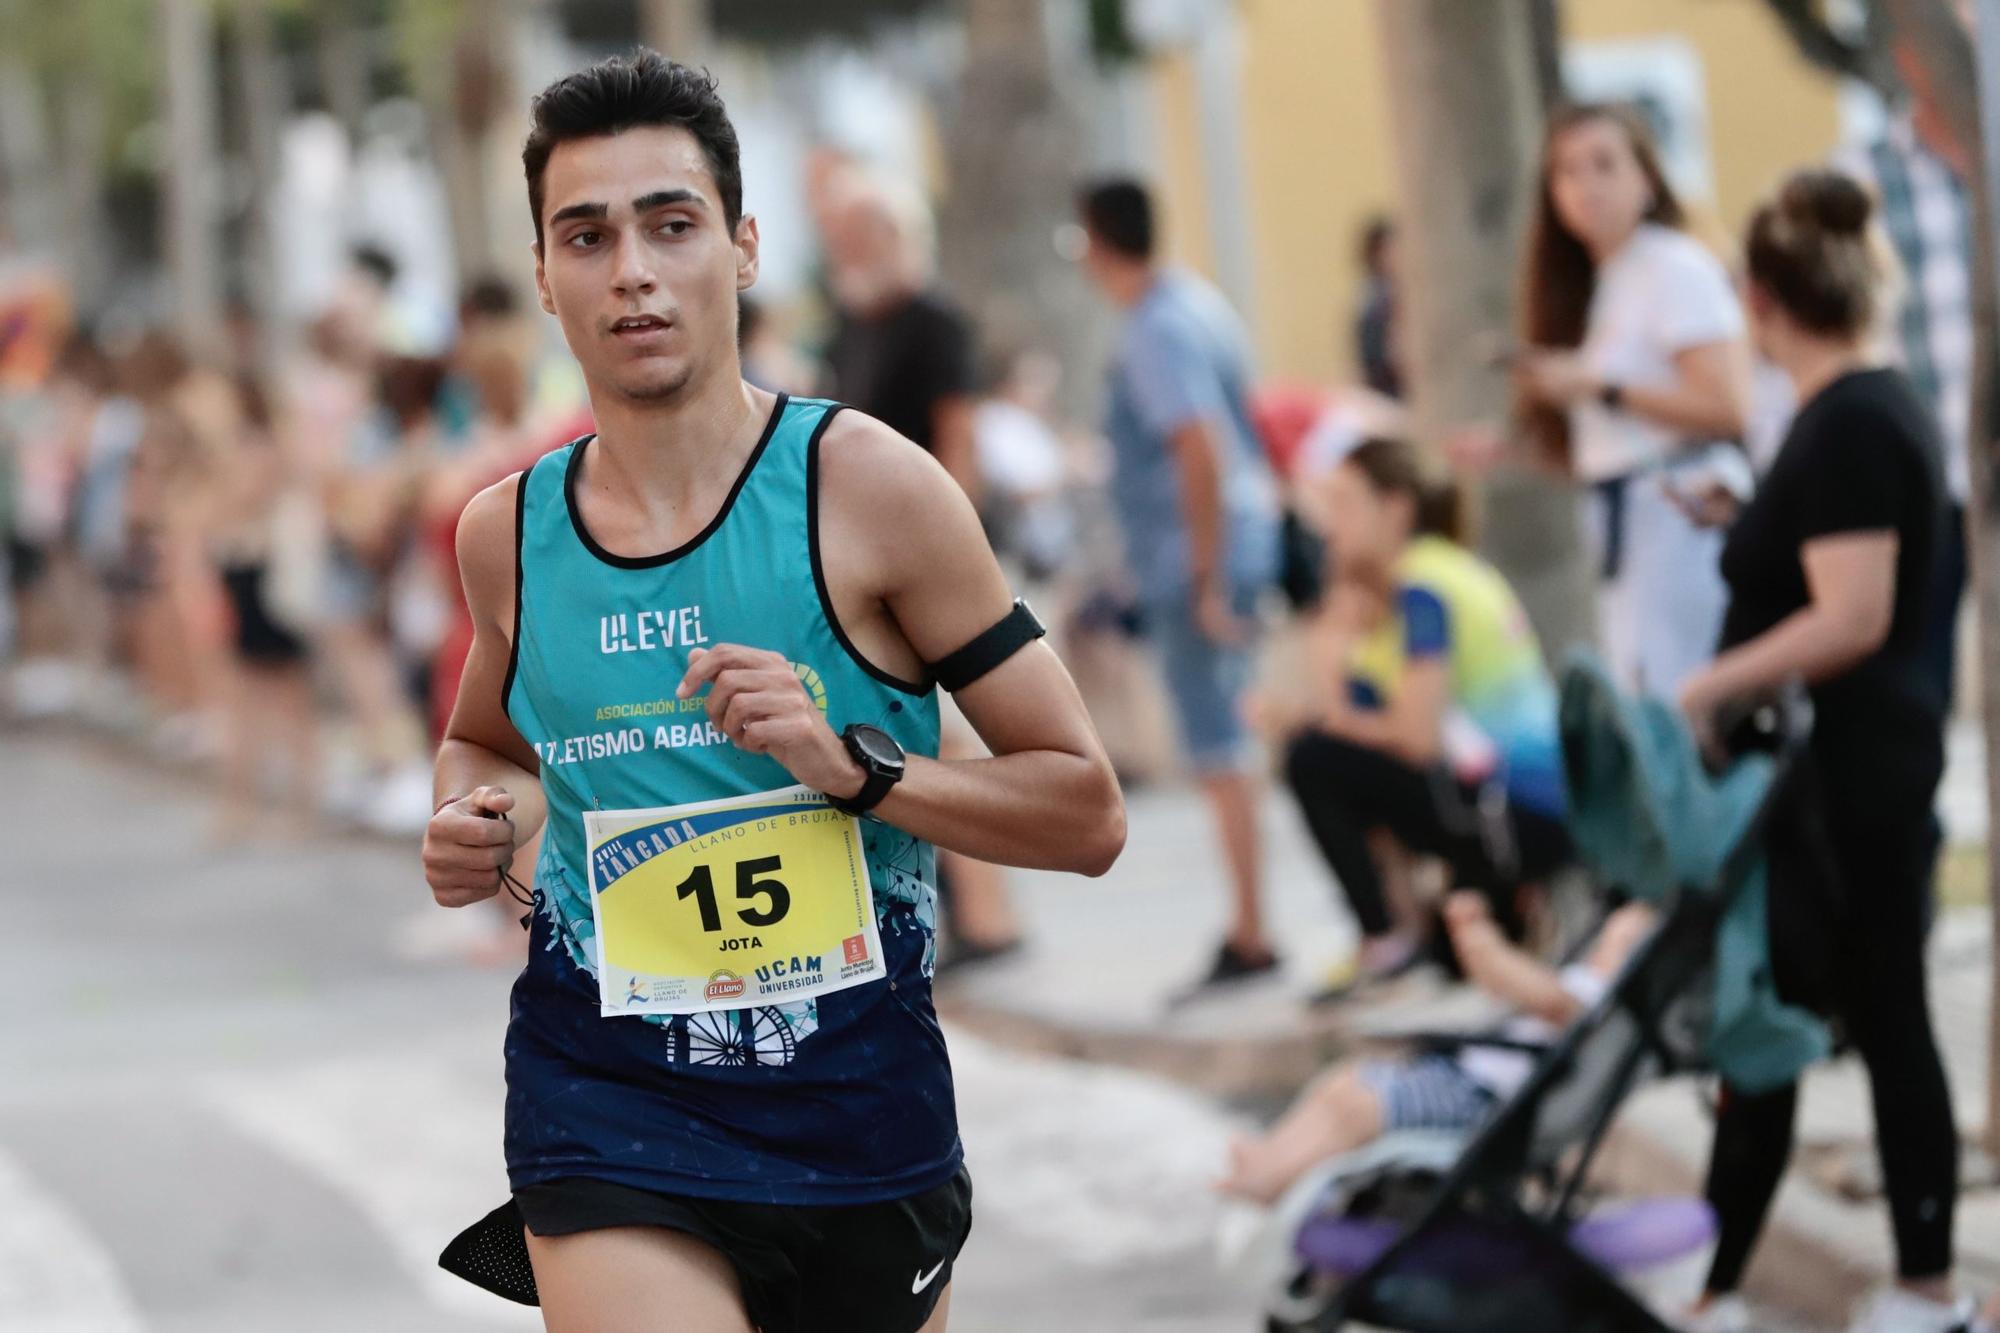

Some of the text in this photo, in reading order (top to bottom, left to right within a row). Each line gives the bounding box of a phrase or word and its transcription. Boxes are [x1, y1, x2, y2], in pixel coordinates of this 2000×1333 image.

[595, 699, 675, 721] ASOCIACIÓN
[690, 811, 848, 854] LLANO DE BRUJAS
[595, 840, 623, 864] XVIII
[598, 820, 698, 884] ZANCADA
[676, 855, 790, 932] 15
[719, 937, 762, 951] JOTA
[754, 956, 821, 983] UCAM
[709, 983, 742, 995] El Llano
[759, 973, 824, 994] UNIVERSIDAD
